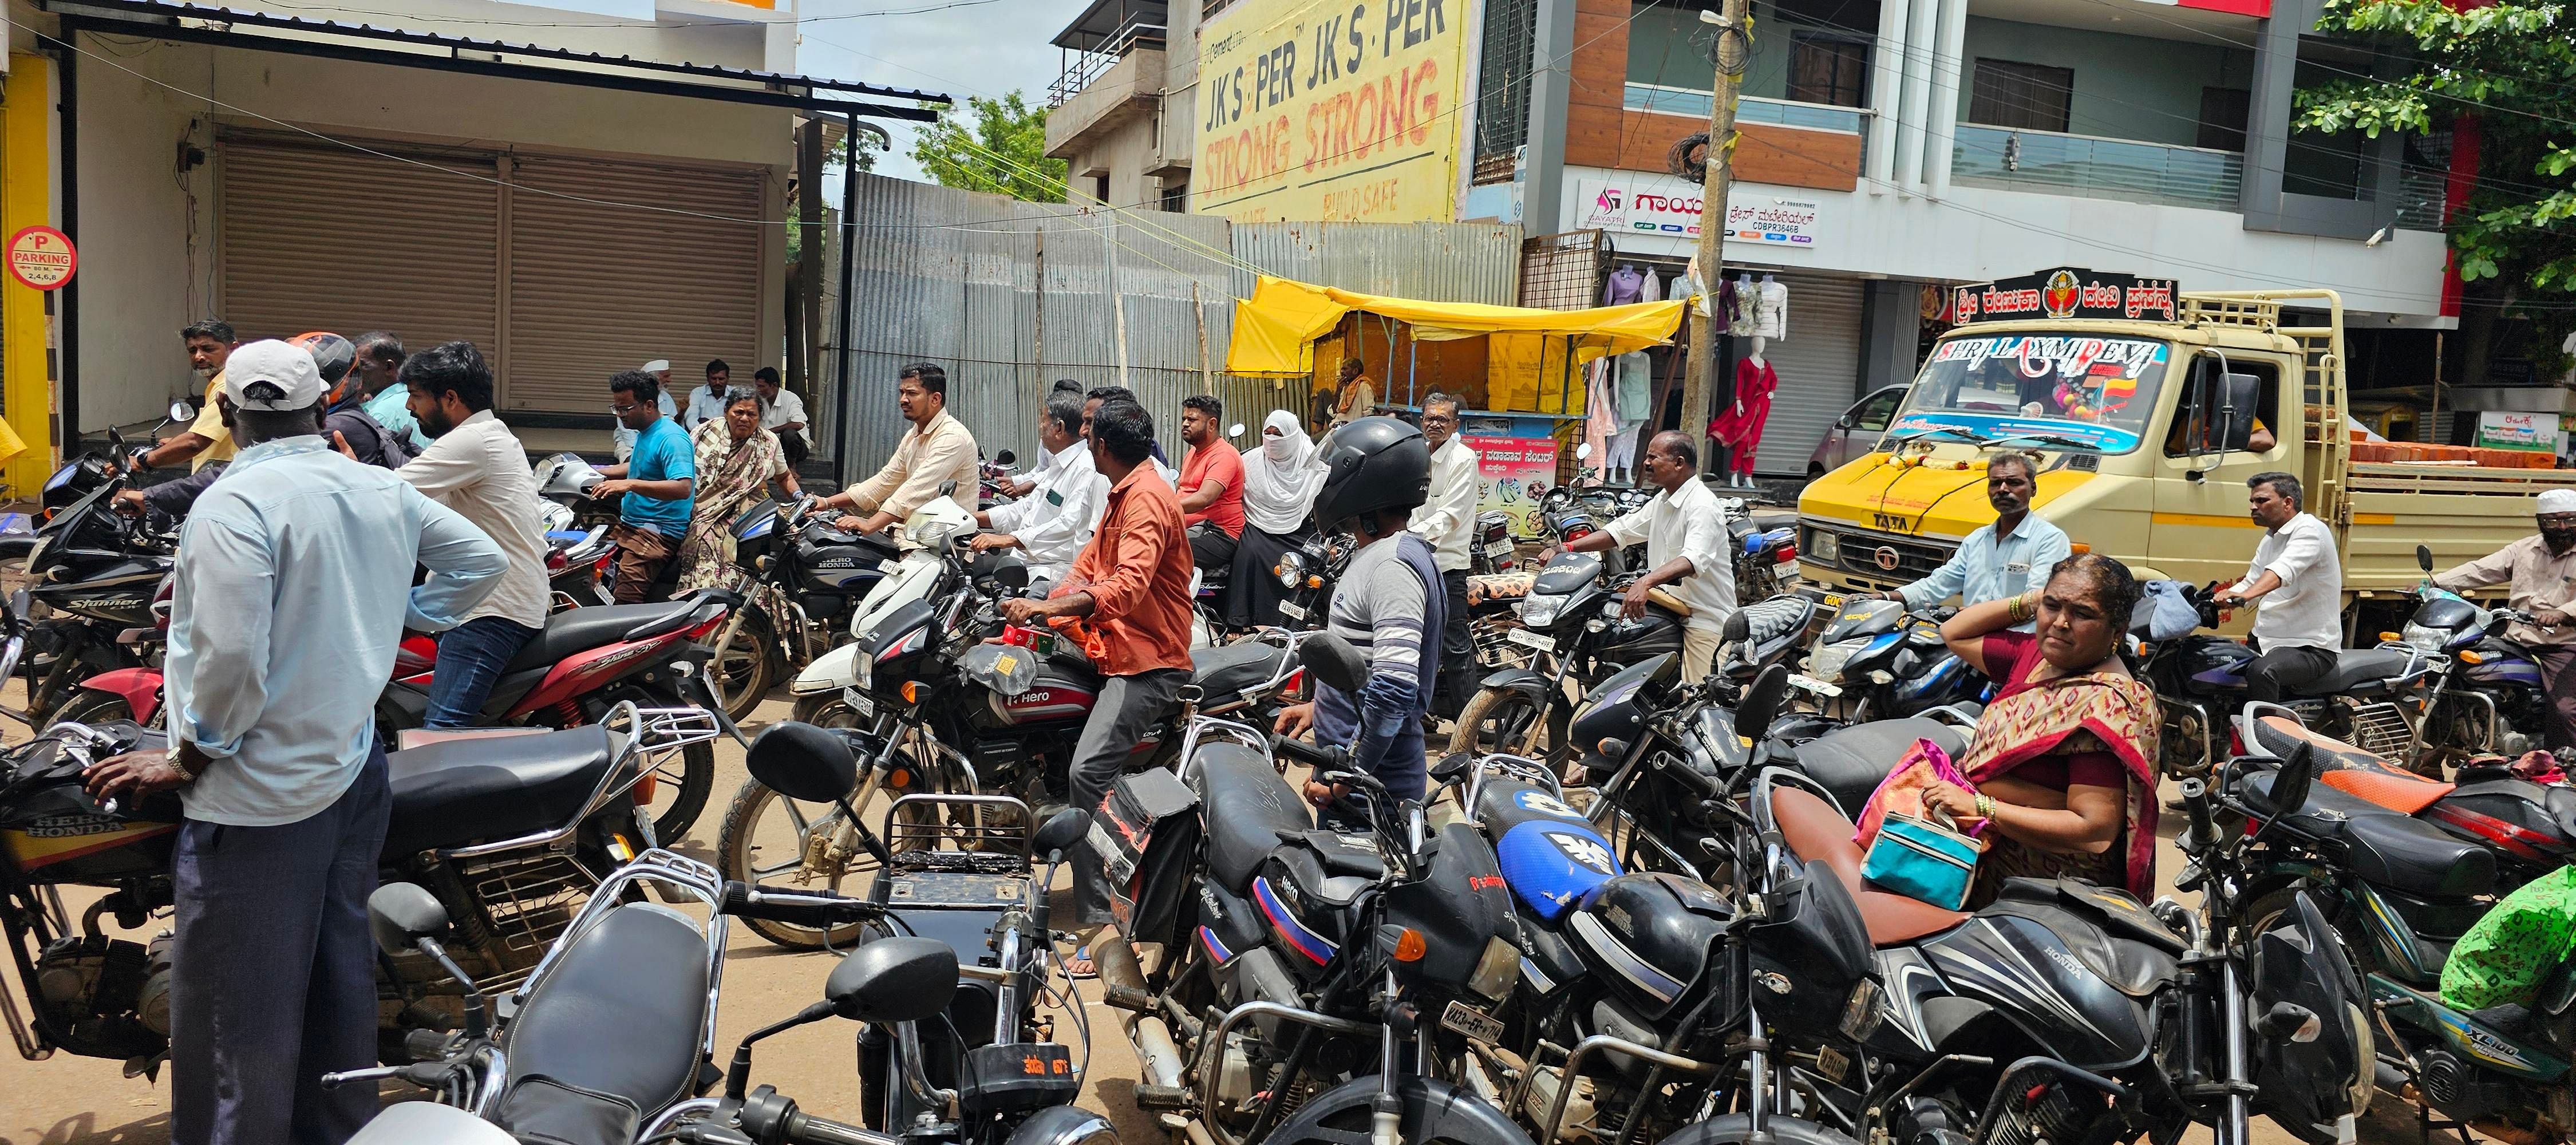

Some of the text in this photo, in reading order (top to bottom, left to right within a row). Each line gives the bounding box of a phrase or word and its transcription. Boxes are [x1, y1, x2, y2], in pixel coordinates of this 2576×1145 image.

[1206, 73, 1229, 132] JK
[1307, 14, 1342, 90] JK
[1203, 58, 1439, 199] STRONG STRONG
[1363, 178, 1400, 216] SAFE
[35, 235, 48, 250] P
[15, 253, 69, 264] PARKING
[1957, 280, 2175, 324] ಶ್ರೀ ರೇಣುಕಾ ದೇವಿ ಪ್ರಸನ್ನ
[1873, 513, 1909, 531] TATA
[69, 599, 144, 609] Stunner
[1021, 692, 1049, 704] Hero
[26, 820, 126, 837] HONDA
[1281, 875, 1298, 902] Hero
[2044, 945, 2081, 980] HONDA
